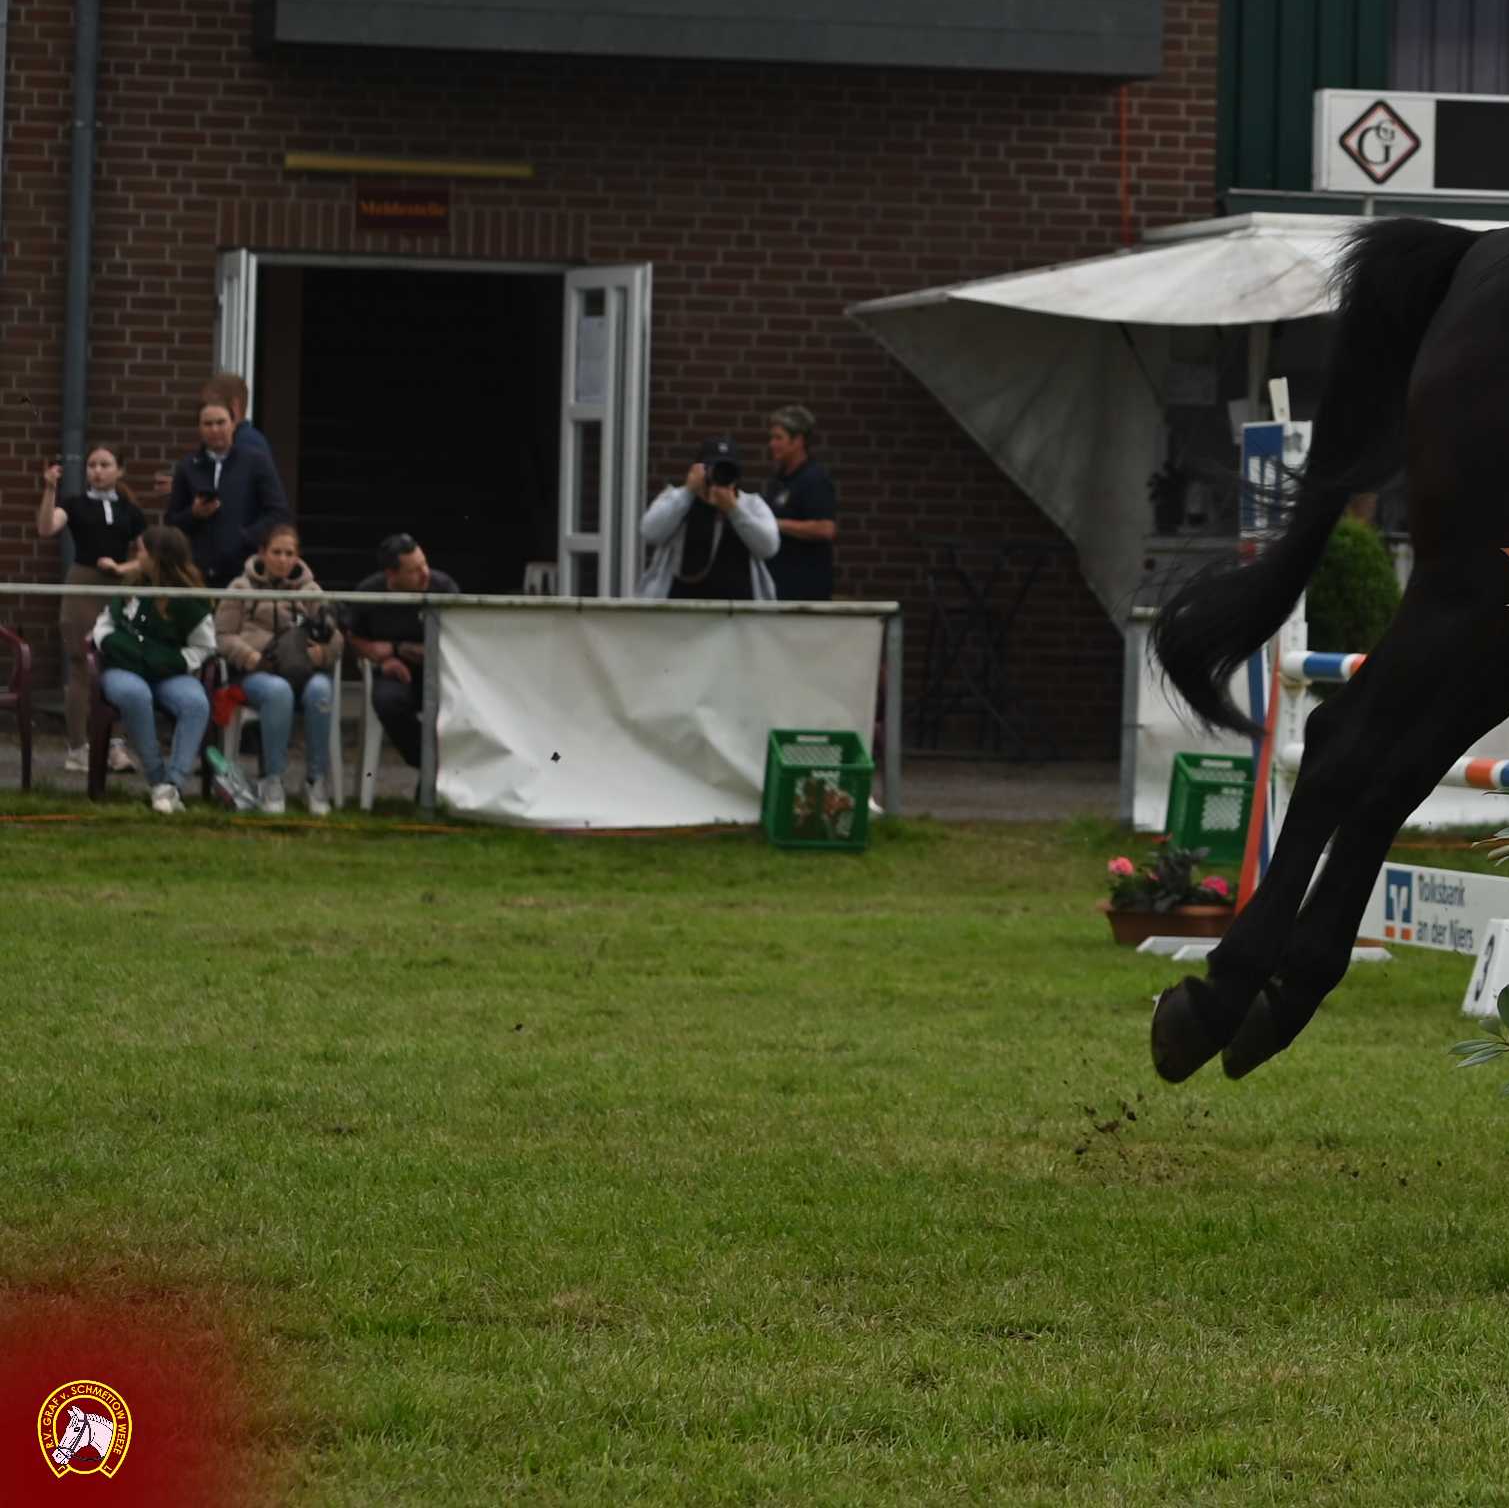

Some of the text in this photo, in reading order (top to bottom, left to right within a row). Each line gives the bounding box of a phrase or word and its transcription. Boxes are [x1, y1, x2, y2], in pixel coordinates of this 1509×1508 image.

[1418, 873, 1466, 907] Volksbank
[1417, 921, 1429, 941] an
[1431, 915, 1447, 943] der
